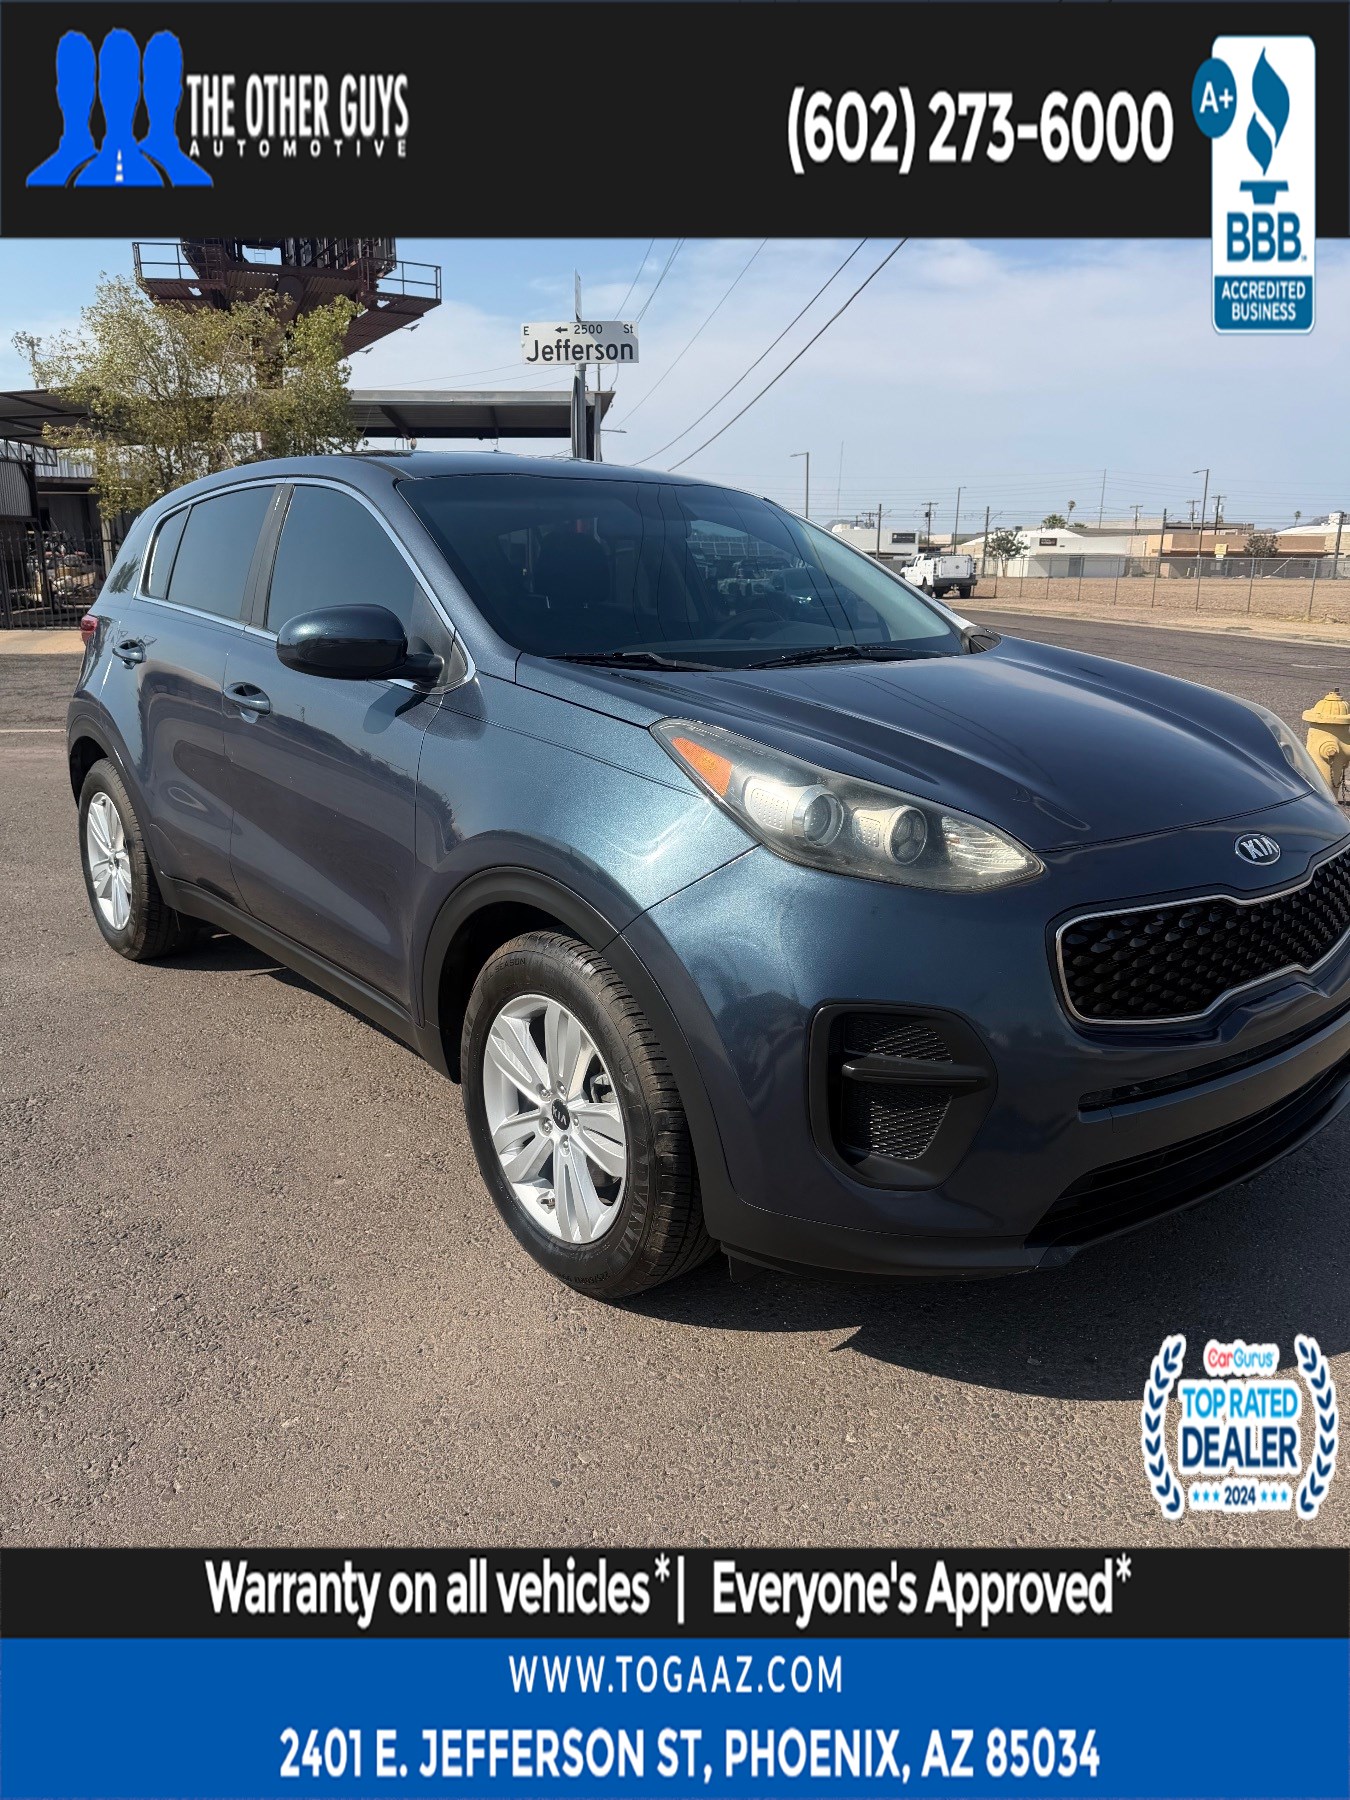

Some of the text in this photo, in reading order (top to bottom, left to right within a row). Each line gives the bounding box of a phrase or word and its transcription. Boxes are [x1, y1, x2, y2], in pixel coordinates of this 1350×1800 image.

[523, 324, 634, 336] E 2500 St
[526, 339, 634, 362] Jefferson
[1240, 837, 1279, 860] KIA
[553, 1105, 567, 1126] KIA
